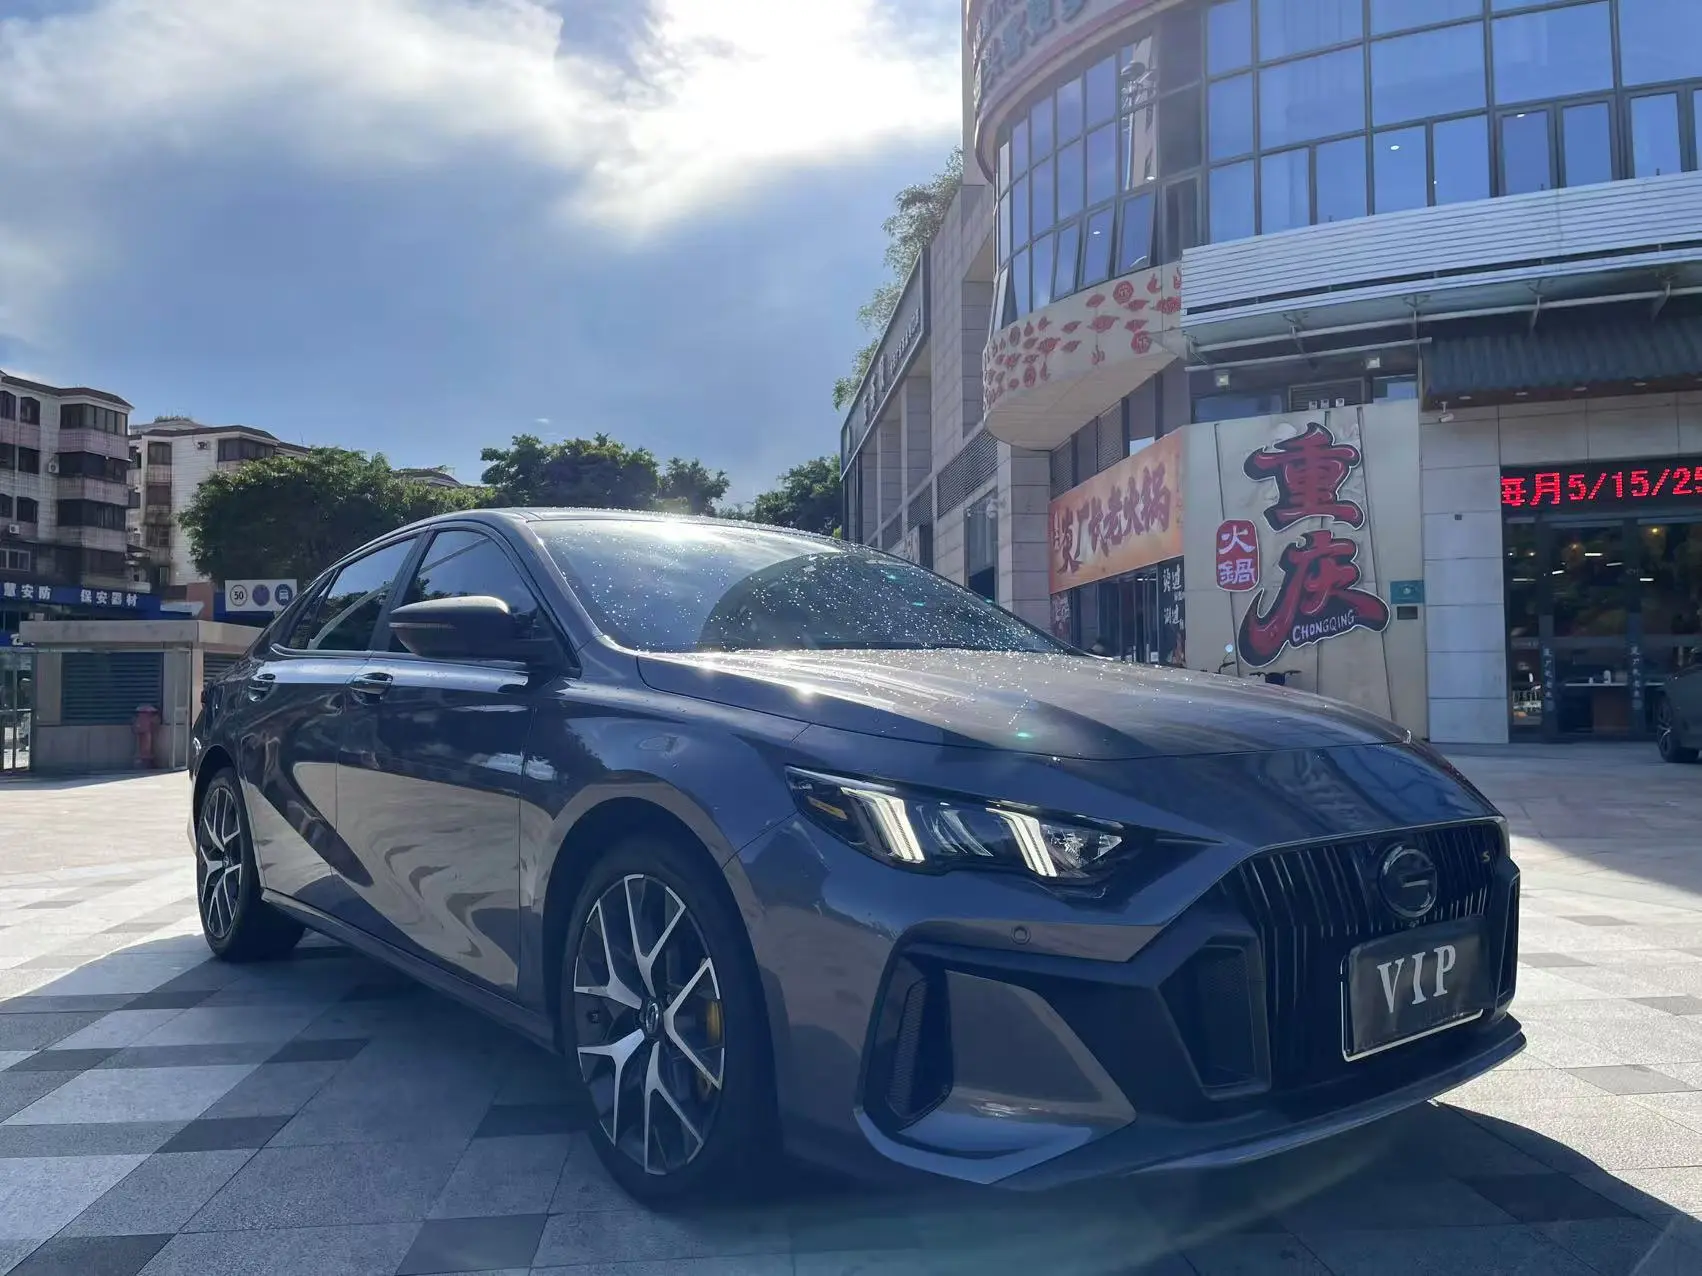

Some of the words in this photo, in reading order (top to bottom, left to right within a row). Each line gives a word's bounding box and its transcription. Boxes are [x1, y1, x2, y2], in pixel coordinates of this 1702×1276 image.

[80, 589, 138, 607] 保安器材
[233, 591, 244, 600] 50
[1292, 608, 1355, 641] CHONGQING
[1376, 944, 1457, 1014] VIP
